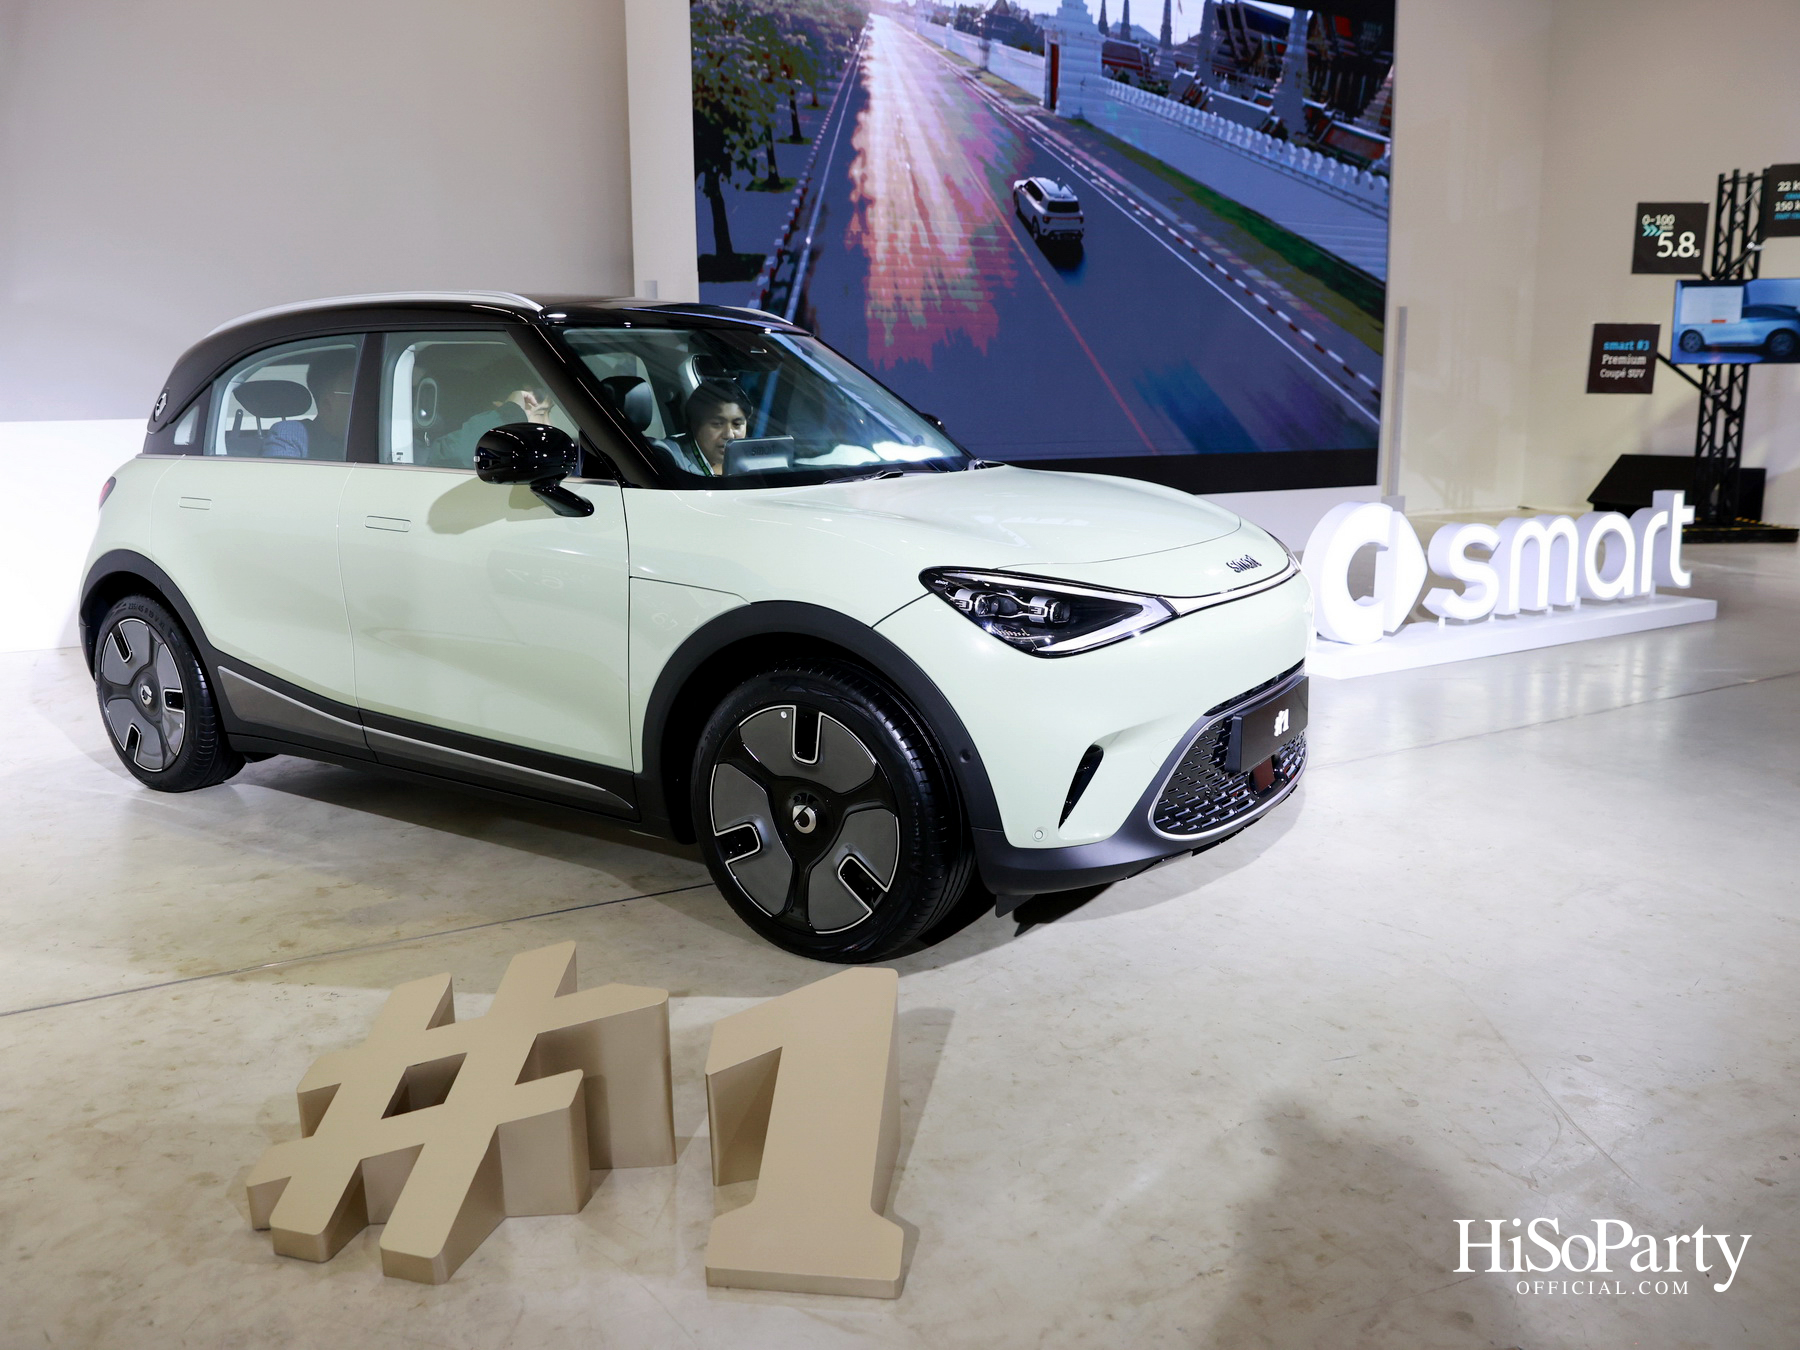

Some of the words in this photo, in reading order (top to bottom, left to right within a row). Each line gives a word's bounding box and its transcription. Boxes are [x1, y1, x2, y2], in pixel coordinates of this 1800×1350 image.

[1641, 214, 1676, 226] 0-100
[1601, 353, 1647, 365] Premium
[1225, 553, 1263, 573] smart
[1422, 489, 1695, 621] smart
